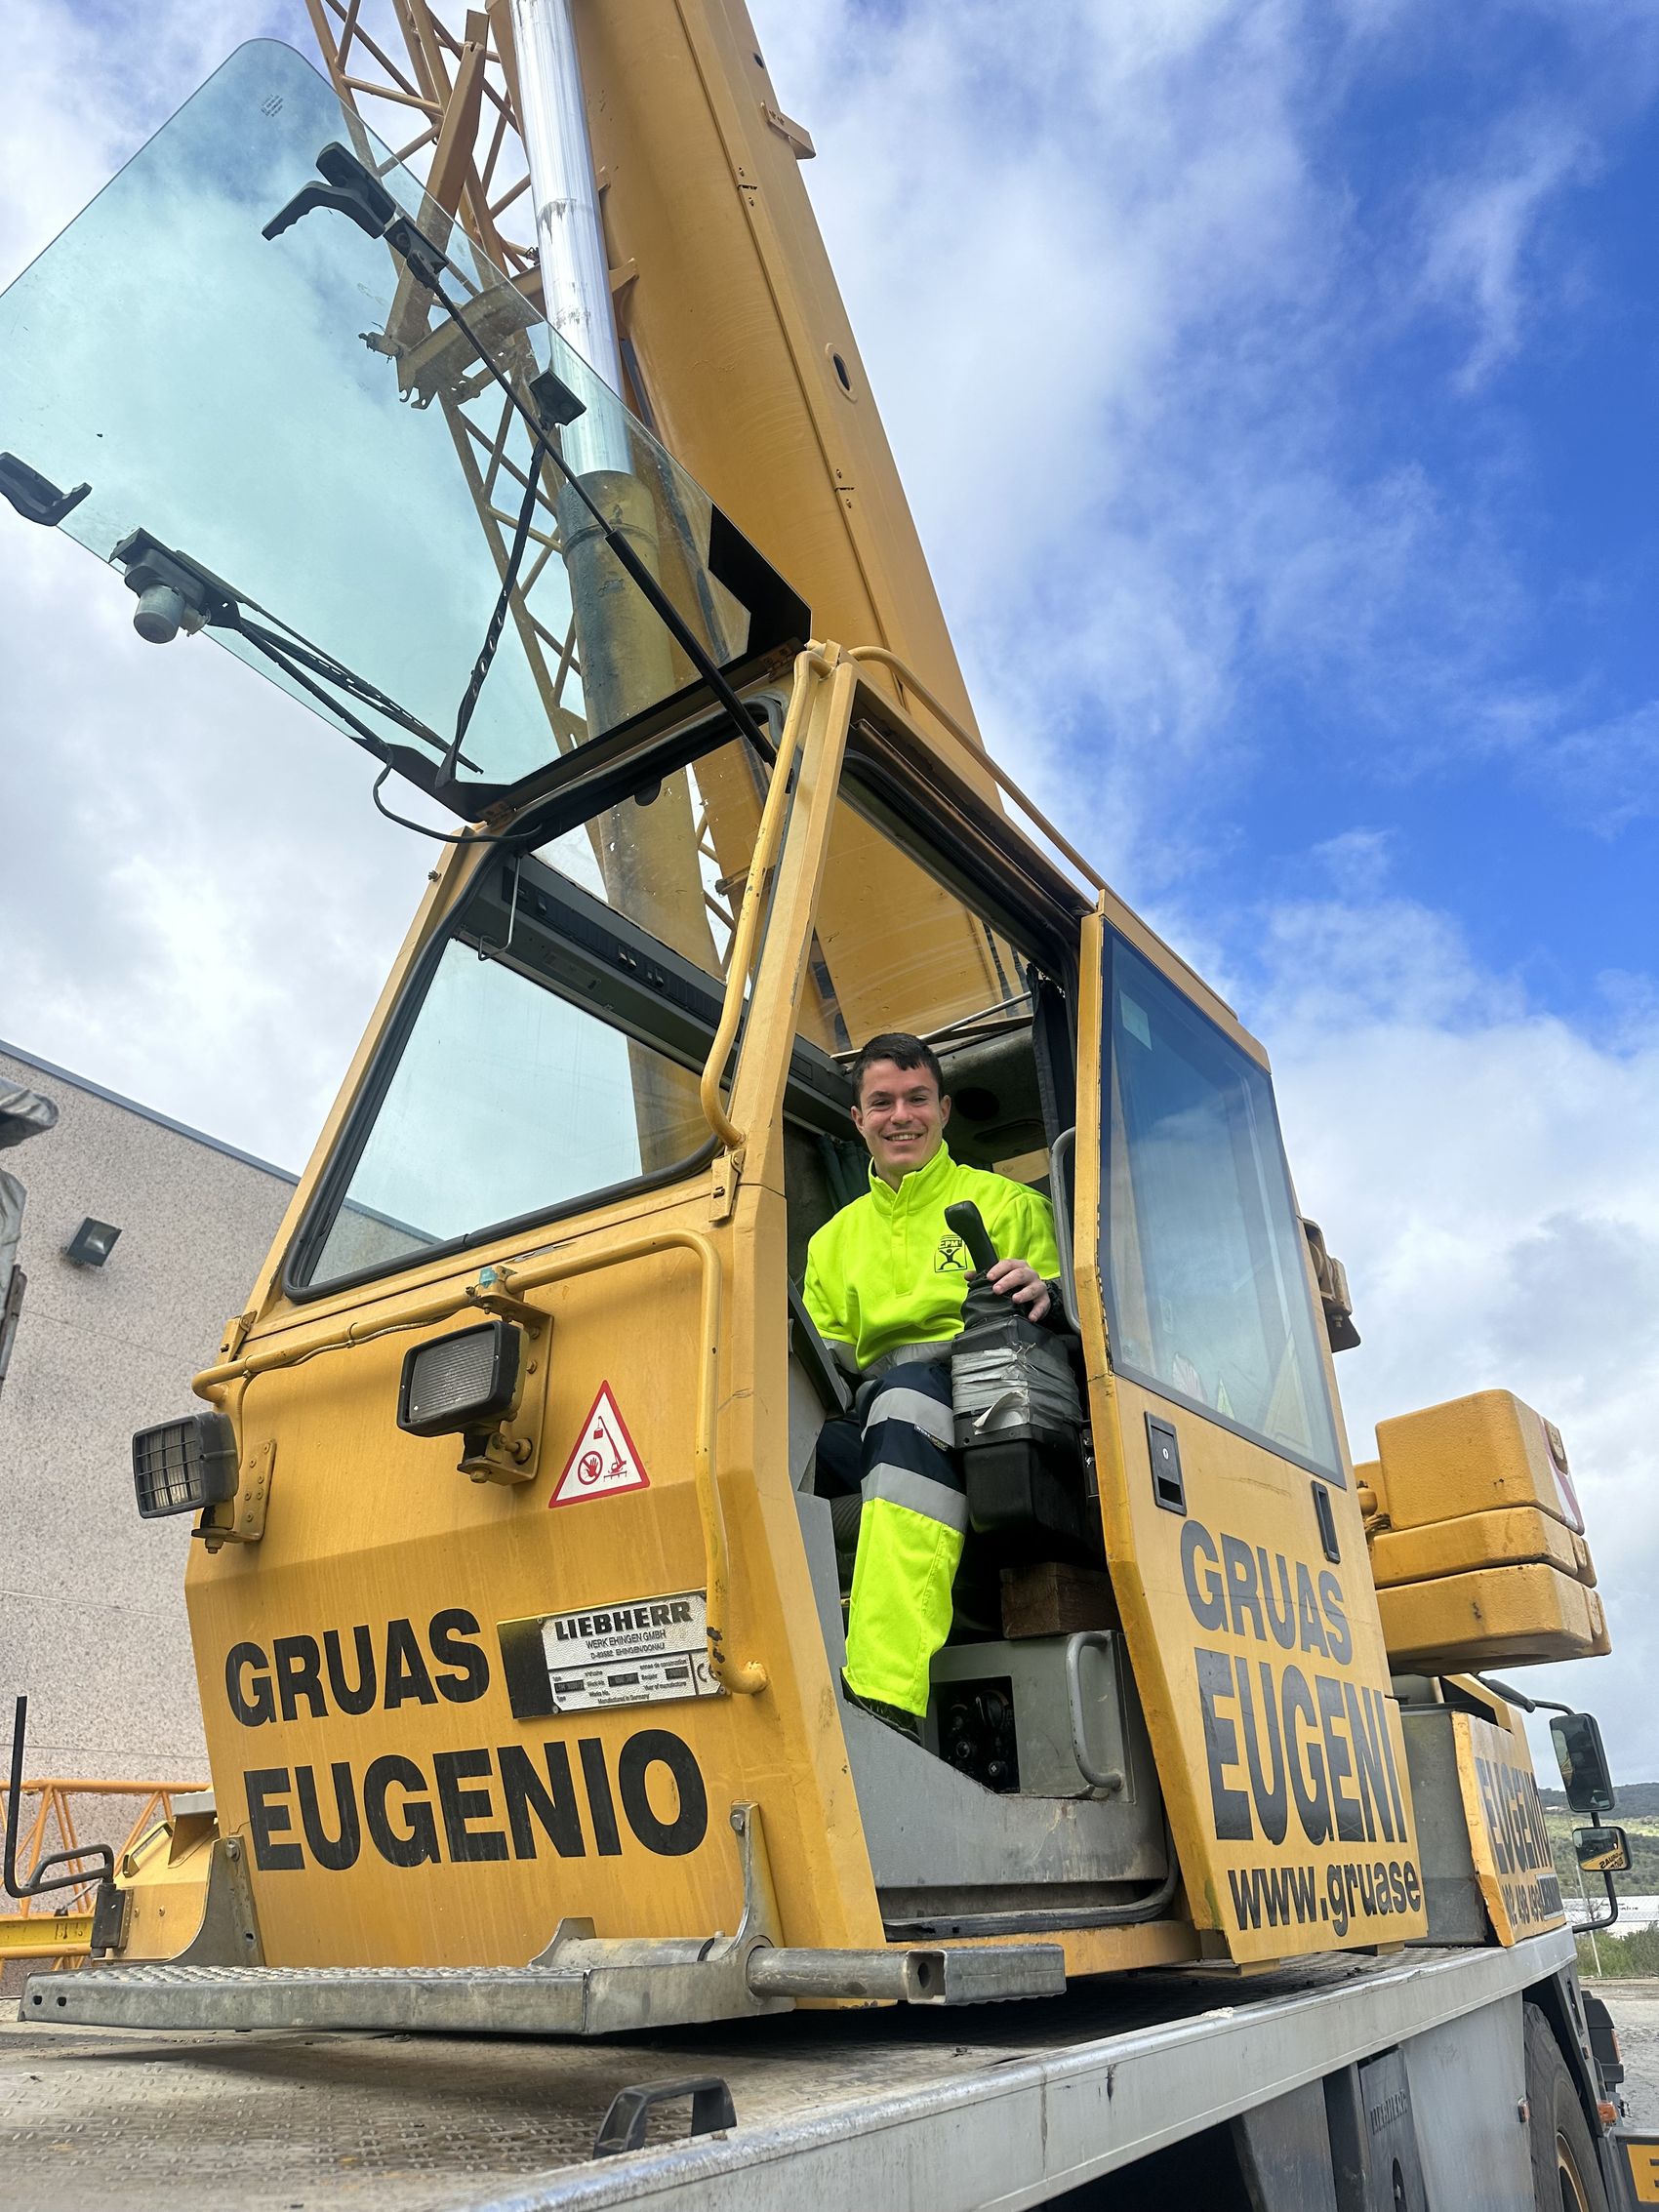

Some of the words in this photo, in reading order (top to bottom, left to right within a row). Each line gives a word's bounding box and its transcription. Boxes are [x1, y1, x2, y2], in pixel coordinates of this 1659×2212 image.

[554, 1601, 694, 1641] LIEBHERR
[586, 1637, 608, 1649] WERK
[608, 1633, 643, 1646] EHINGEN
[1180, 1519, 1353, 1665] GRUAS
[226, 1608, 490, 1727] GRUAS
[244, 1729, 708, 1871] EUGENIO
[1195, 1648, 1406, 1846] EUGENI
[1228, 1861, 1422, 1937] www.gruase
